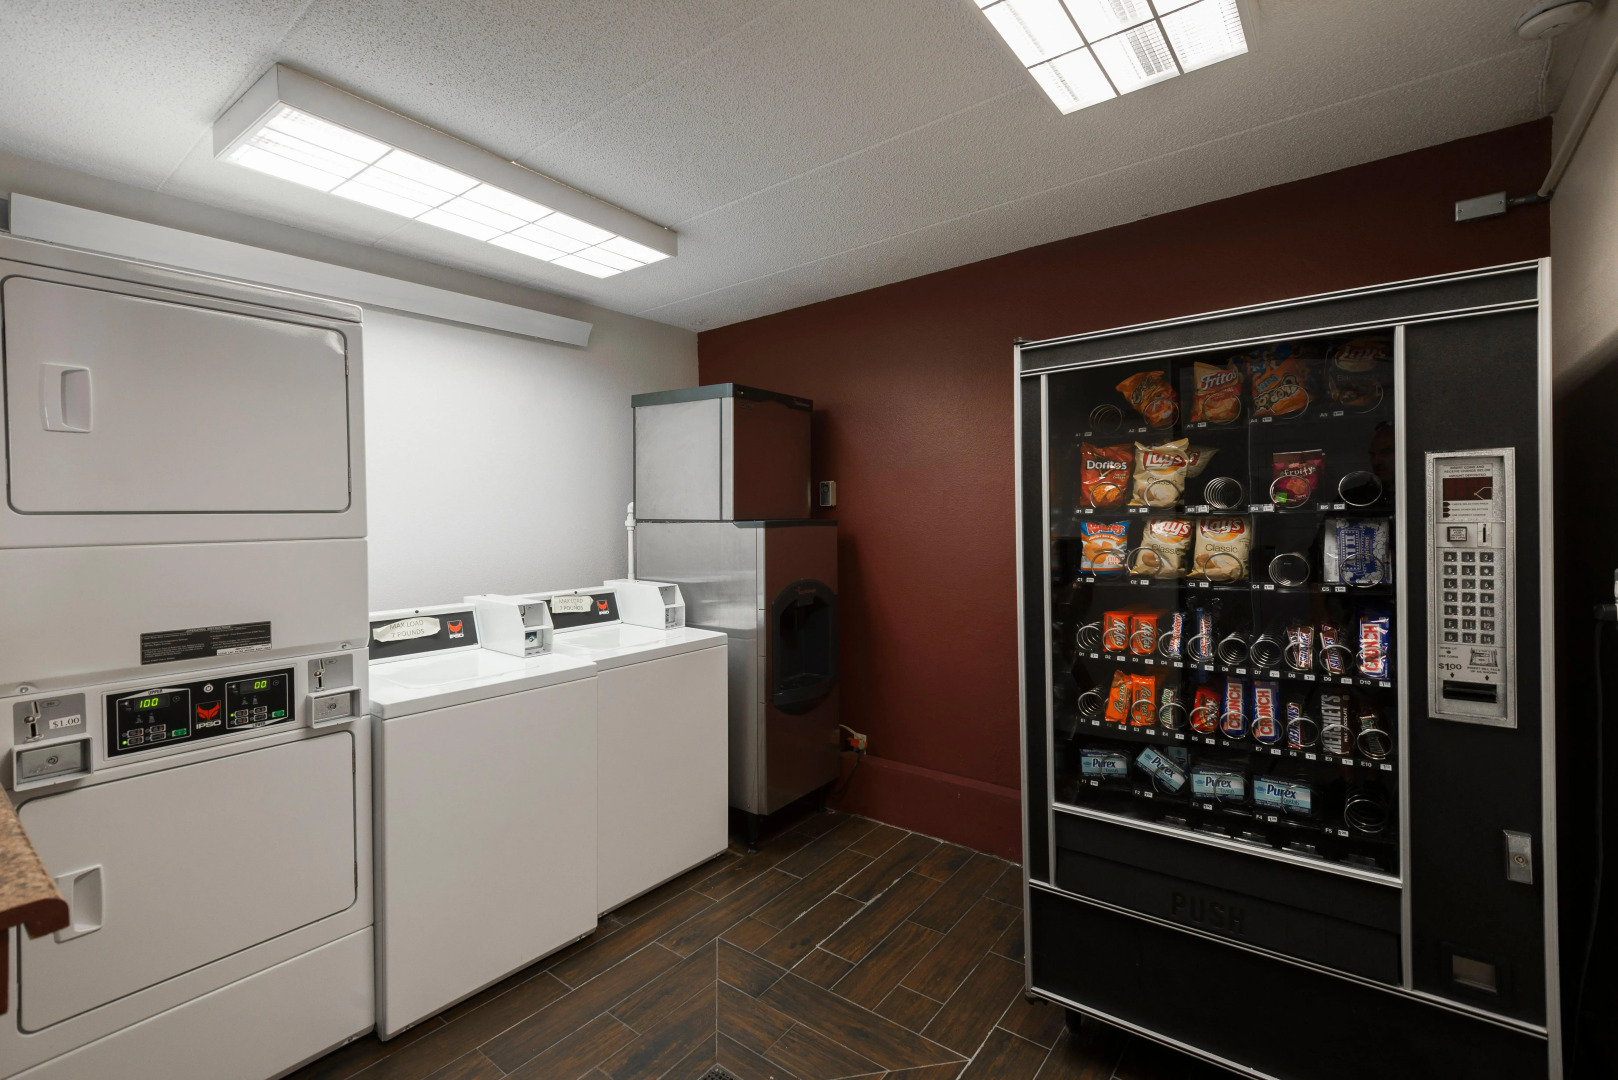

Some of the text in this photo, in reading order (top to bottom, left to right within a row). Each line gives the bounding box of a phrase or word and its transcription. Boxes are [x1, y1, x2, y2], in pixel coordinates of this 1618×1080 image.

[1200, 368, 1238, 390] Fritos
[1086, 460, 1127, 470] Doritos
[1205, 544, 1238, 553] Classic
[1364, 626, 1378, 671] CRUNCH
[254, 680, 267, 690] 00
[140, 698, 159, 708] 100
[1229, 684, 1240, 728] CRUNCH
[1257, 690, 1273, 735] CRUNCH
[53, 717, 80, 728] $1.00
[196, 720, 221, 730] IPSO
[1321, 695, 1341, 753] HERSHEY'S
[1092, 759, 1115, 768] Purex
[1152, 757, 1175, 778] Purex
[1206, 777, 1231, 788] Purex
[1267, 784, 1296, 799] Purex
[1172, 892, 1245, 932] PUSH
